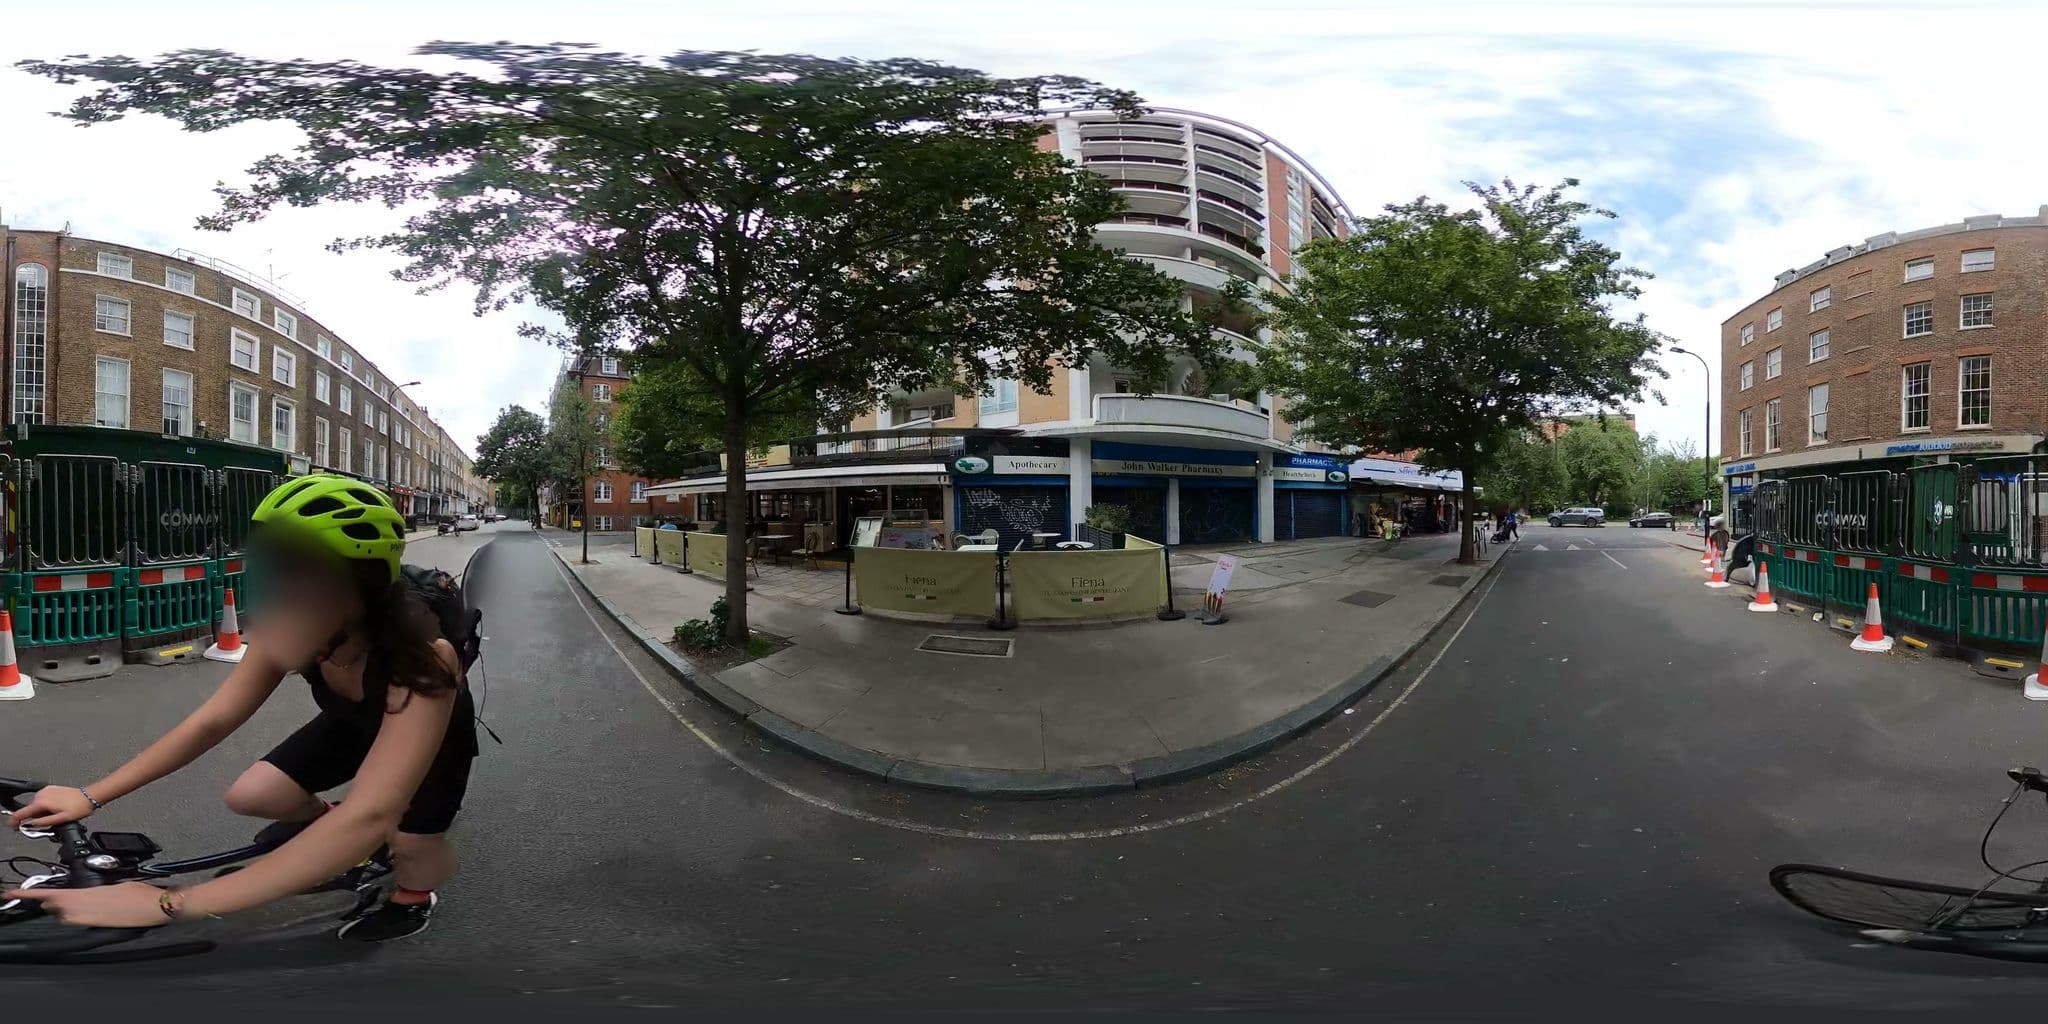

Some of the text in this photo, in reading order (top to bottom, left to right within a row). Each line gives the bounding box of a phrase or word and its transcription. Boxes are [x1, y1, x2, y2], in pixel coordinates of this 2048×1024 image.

[1009, 460, 1058, 471] Apothecary
[1122, 462, 1224, 475] John Walker Pharmacy
[160, 512, 219, 527] CONWAY
[1816, 512, 1867, 526] CONWAY
